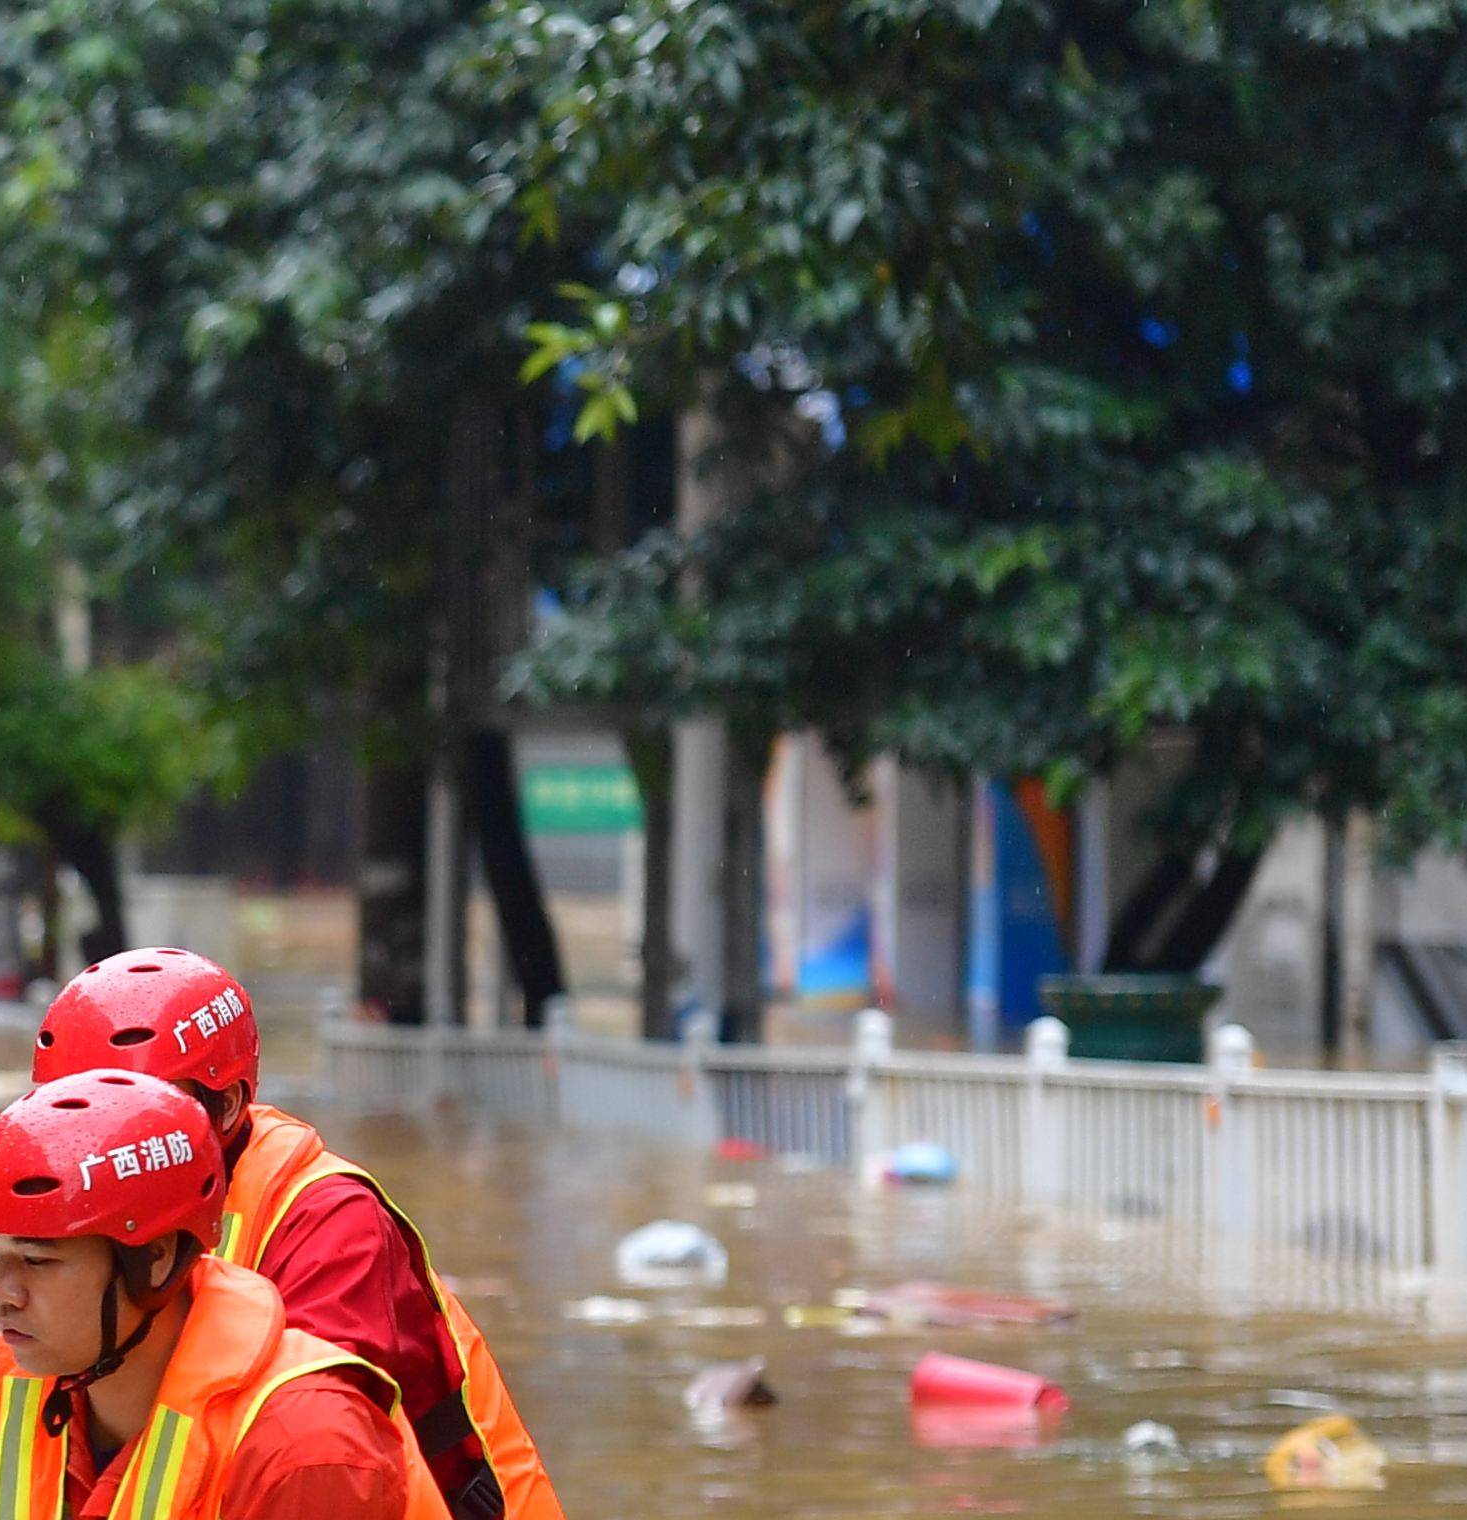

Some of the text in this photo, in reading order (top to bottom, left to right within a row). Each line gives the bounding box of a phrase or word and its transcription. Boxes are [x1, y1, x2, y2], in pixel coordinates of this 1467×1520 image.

[172, 987, 244, 1054] 广西消防
[78, 1129, 195, 1192] 广西消防
